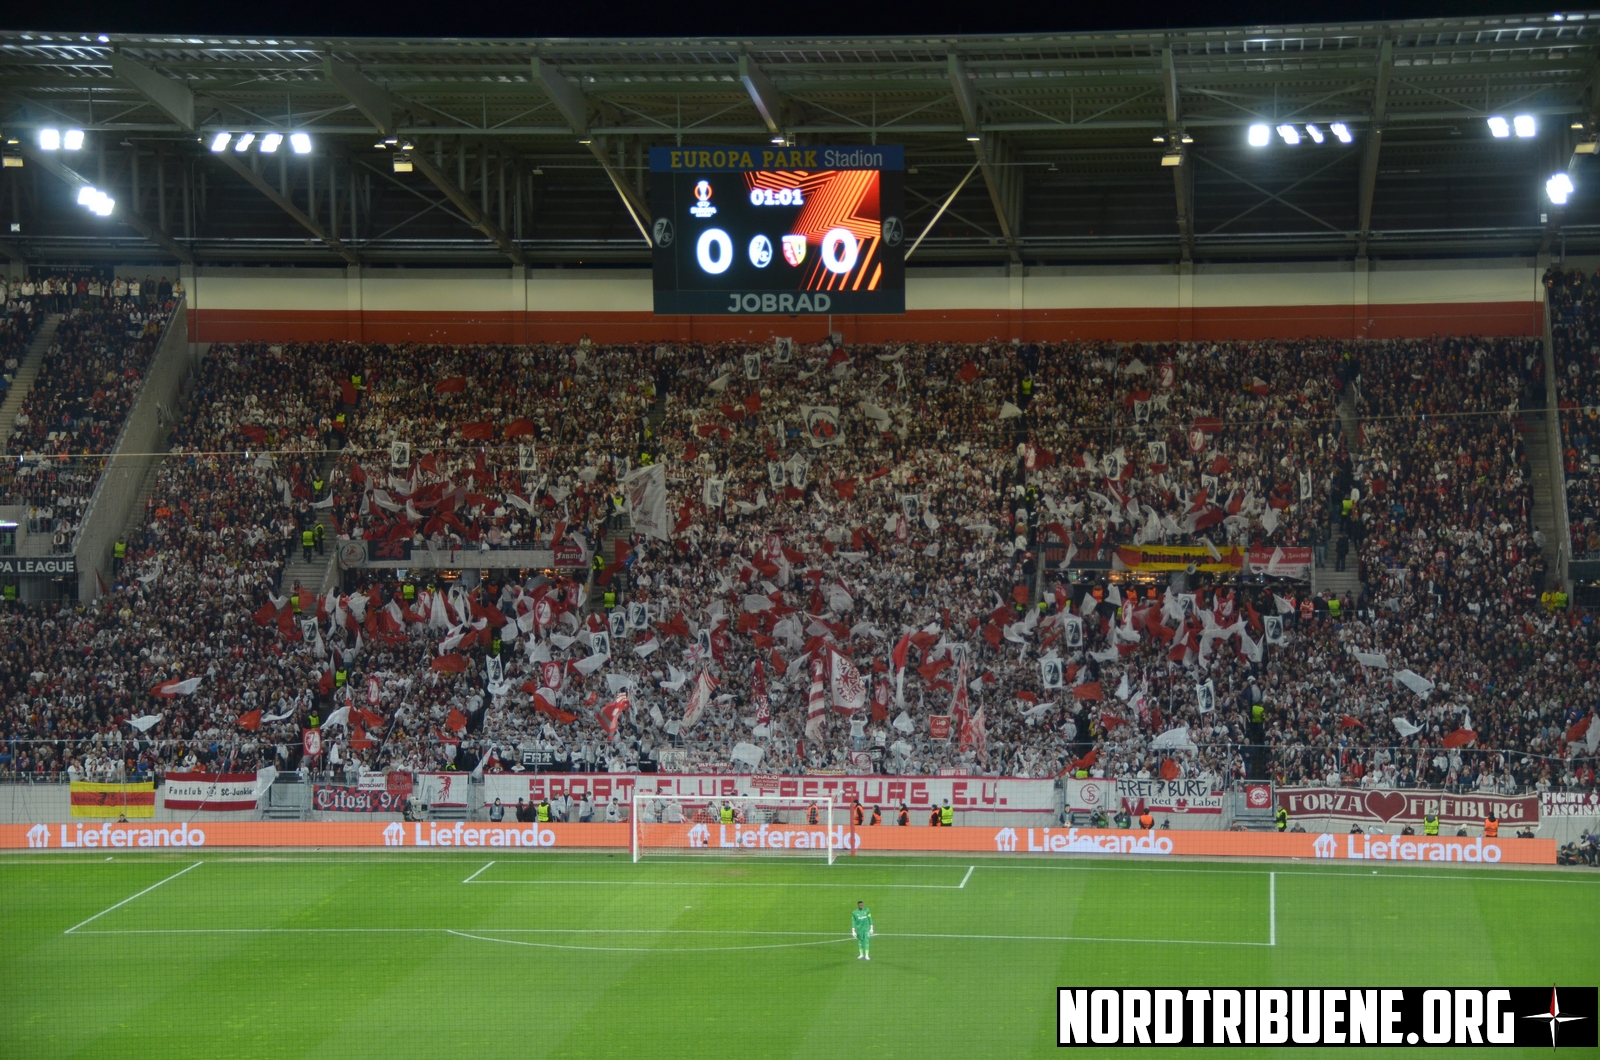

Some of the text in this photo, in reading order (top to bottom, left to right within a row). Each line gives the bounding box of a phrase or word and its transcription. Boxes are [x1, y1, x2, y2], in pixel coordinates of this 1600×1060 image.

[670, 150, 883, 168] EUROPA PARK Stadion
[750, 188, 804, 206] 01:01
[696, 228, 734, 275] 0
[821, 228, 858, 275] 0
[727, 294, 831, 313] JOBRAD
[17, 561, 74, 573] LEAGUE
[1141, 551, 1181, 563] Dreisam
[169, 786, 202, 795] Fanclub
[316, 788, 371, 809] Tifosi
[1168, 780, 1208, 797] BURG
[1541, 792, 1586, 804] FIGHT
[1151, 797, 1221, 807] Red Label
[1289, 794, 1363, 813] FORZA
[1410, 798, 1524, 819] FREIBURG
[61, 822, 205, 847] Lieferando
[415, 821, 555, 847] Lieferando
[720, 823, 861, 849] Lieferando
[1028, 827, 1173, 854] Lieferando
[1347, 833, 1502, 863] Lieferando
